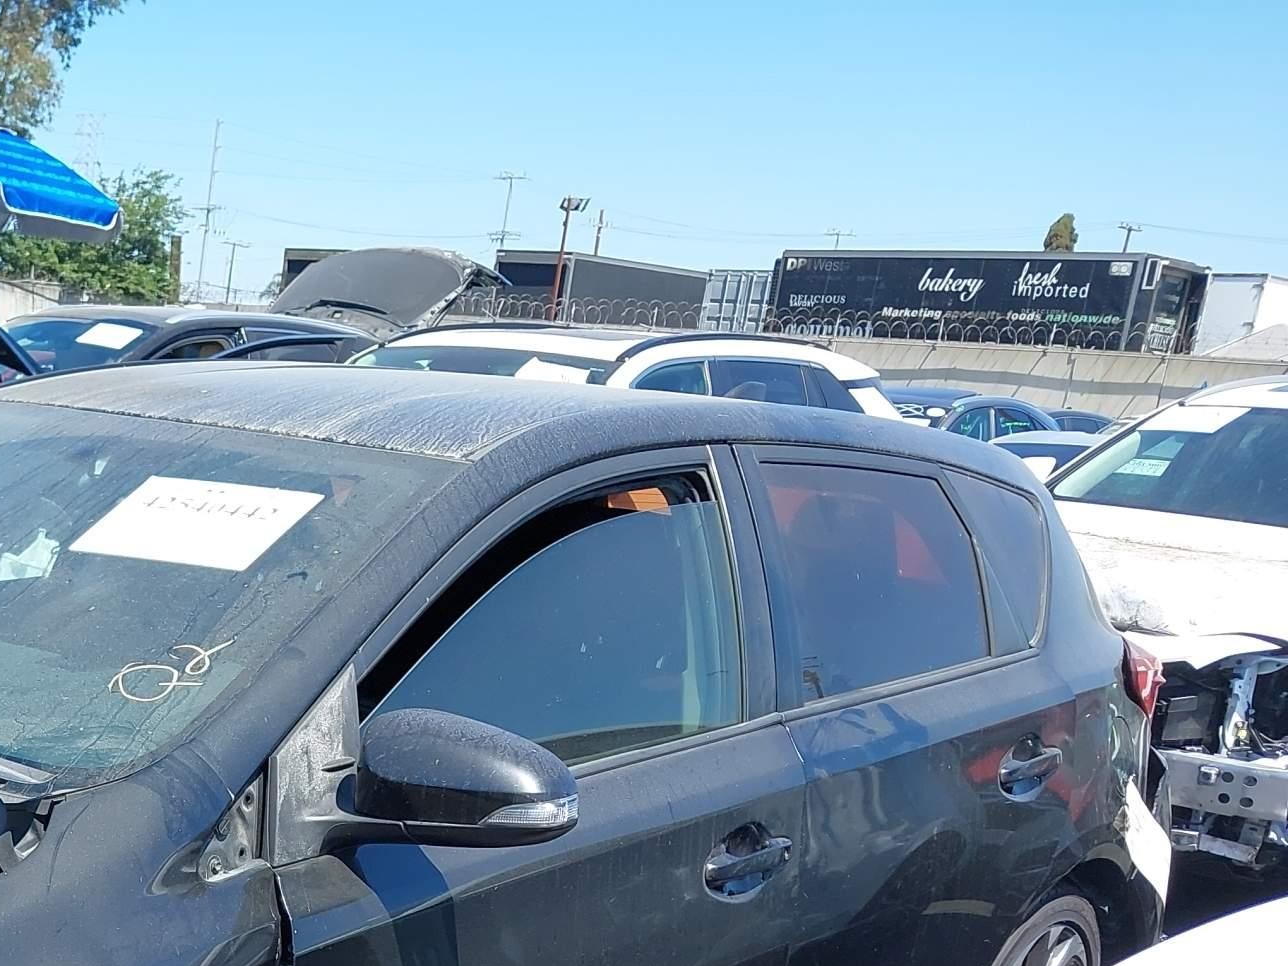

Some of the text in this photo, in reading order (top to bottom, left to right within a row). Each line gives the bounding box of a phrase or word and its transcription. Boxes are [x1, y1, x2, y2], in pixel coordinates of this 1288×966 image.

[918, 267, 985, 302] bakery
[1017, 261, 1063, 293] fresh
[789, 294, 846, 305] DELICIOUS
[1011, 280, 1091, 300] imported
[881, 306, 943, 319] Marketing
[1005, 311, 1042, 322] foods
[1045, 312, 1120, 325] nationwide
